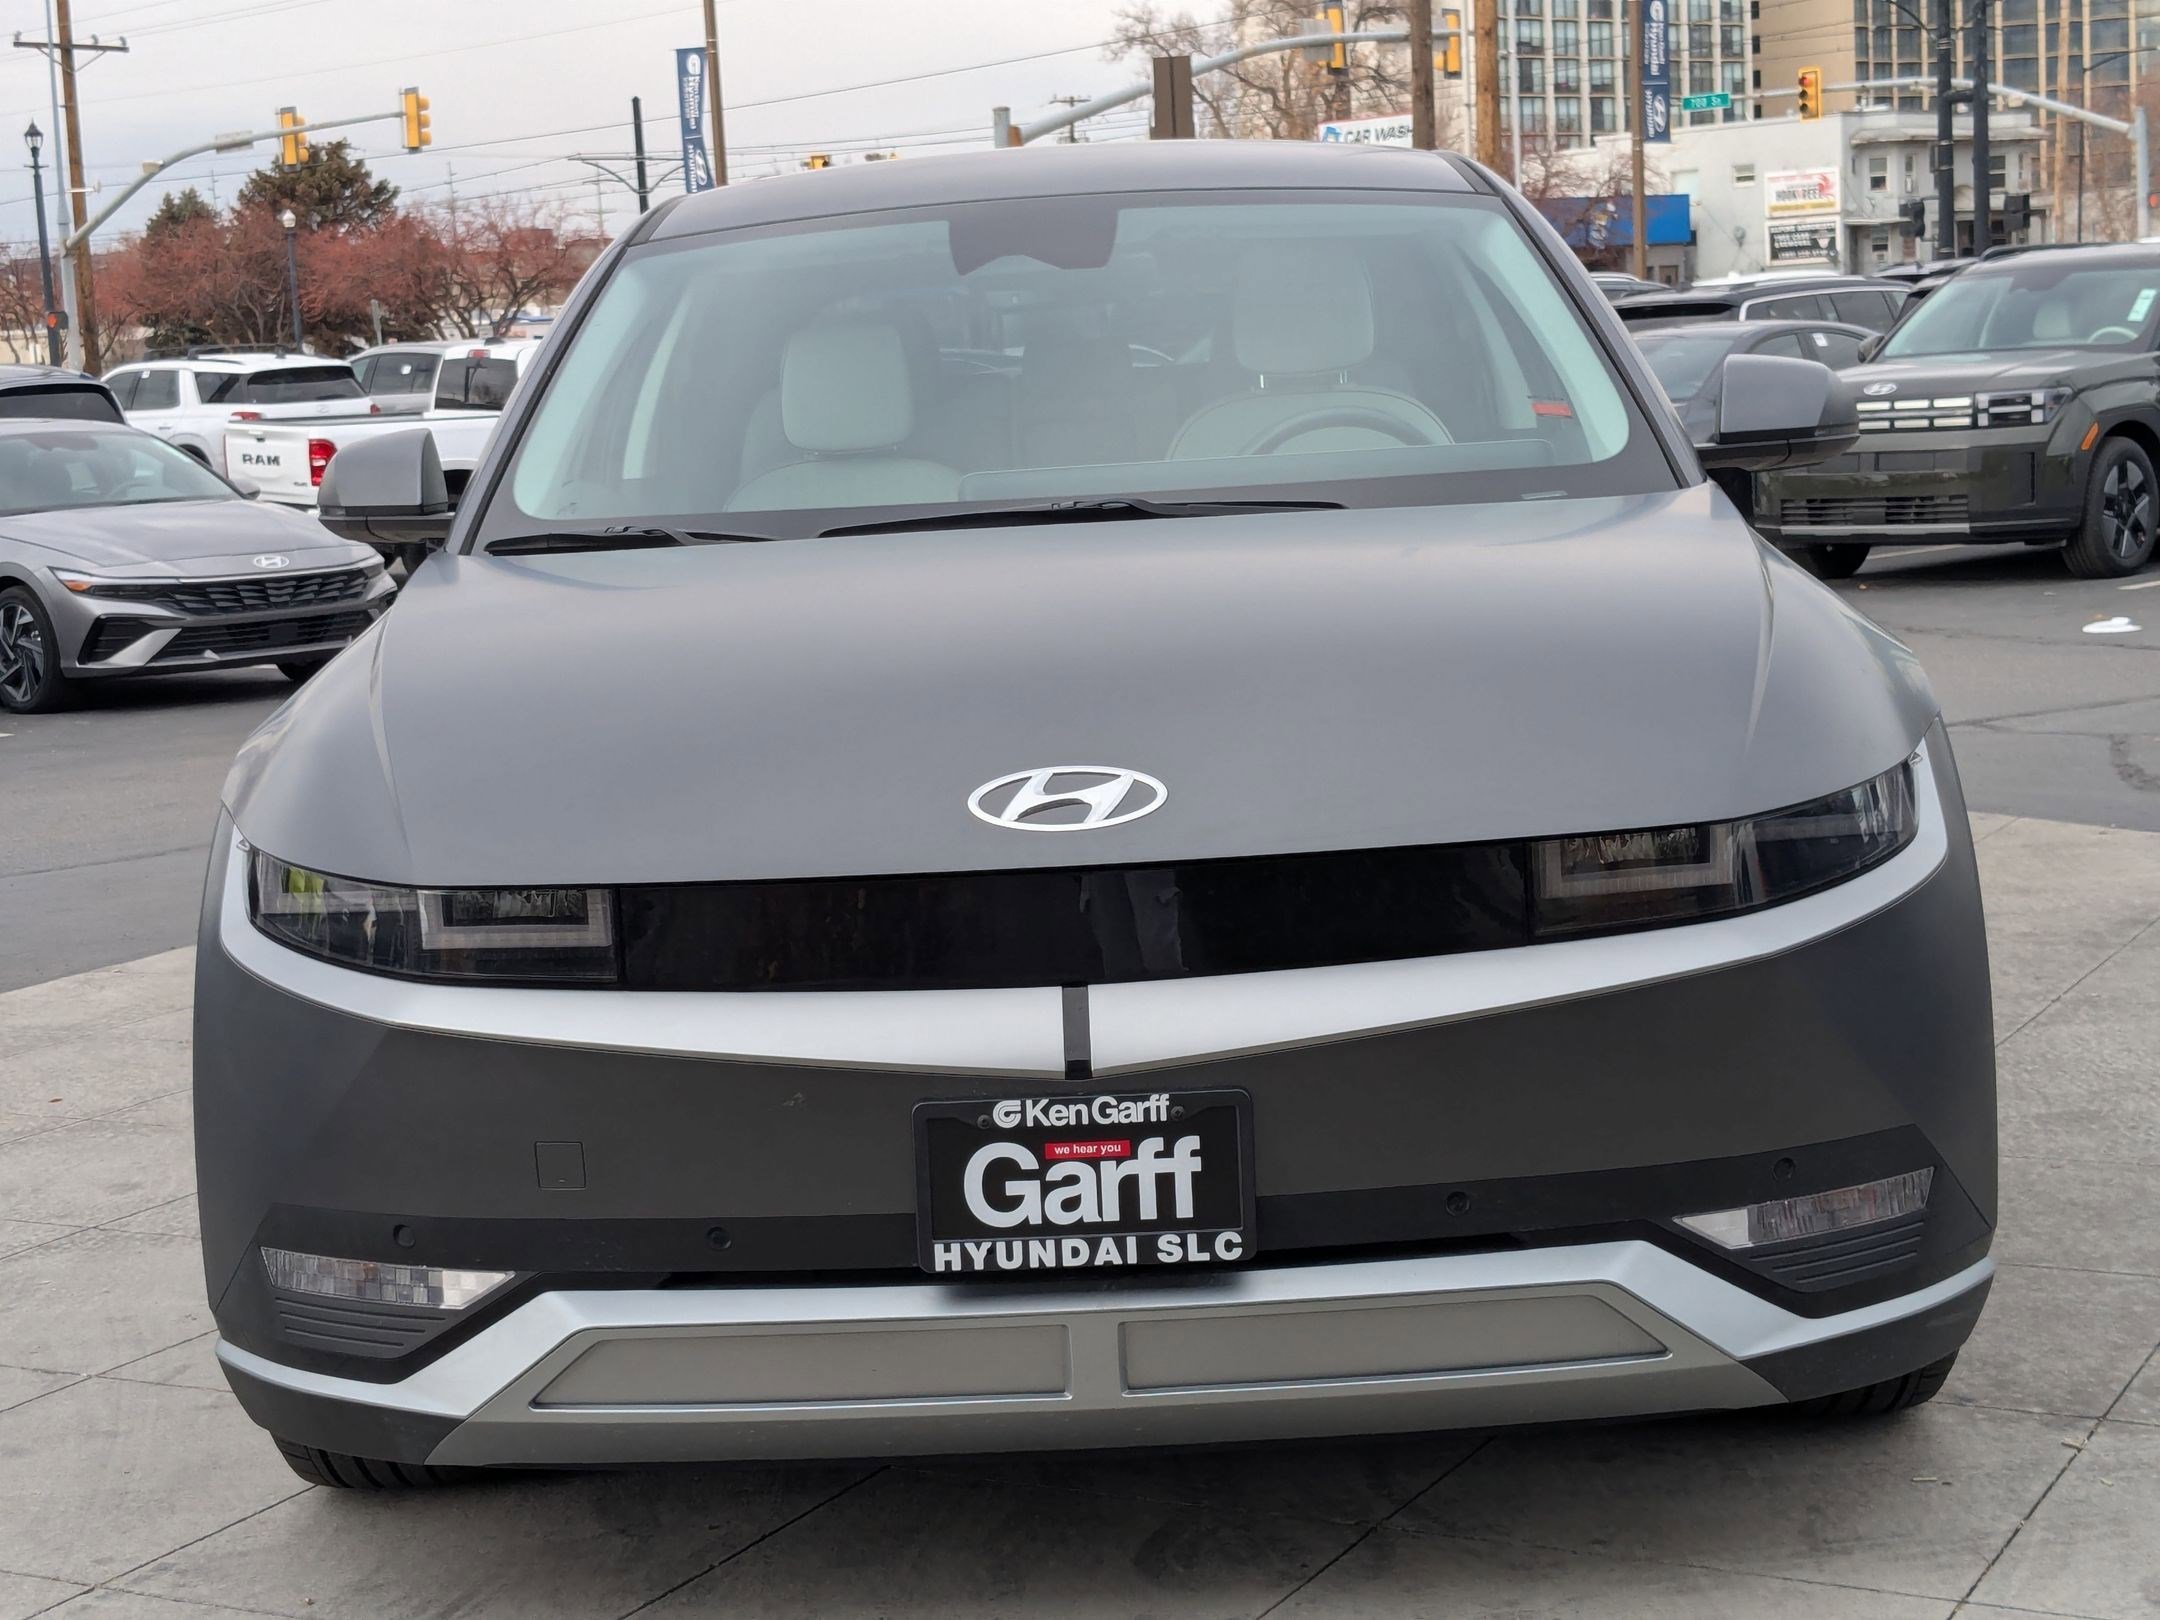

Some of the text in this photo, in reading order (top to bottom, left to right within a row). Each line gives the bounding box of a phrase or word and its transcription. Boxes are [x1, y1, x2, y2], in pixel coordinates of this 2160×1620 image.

[242, 453, 281, 467] RAM
[1026, 1093, 1170, 1127] Ken Garff
[1054, 1144, 1121, 1155] we hear you
[963, 1135, 1202, 1228] Garff
[934, 1231, 1243, 1272] HYUNDAI SLC
